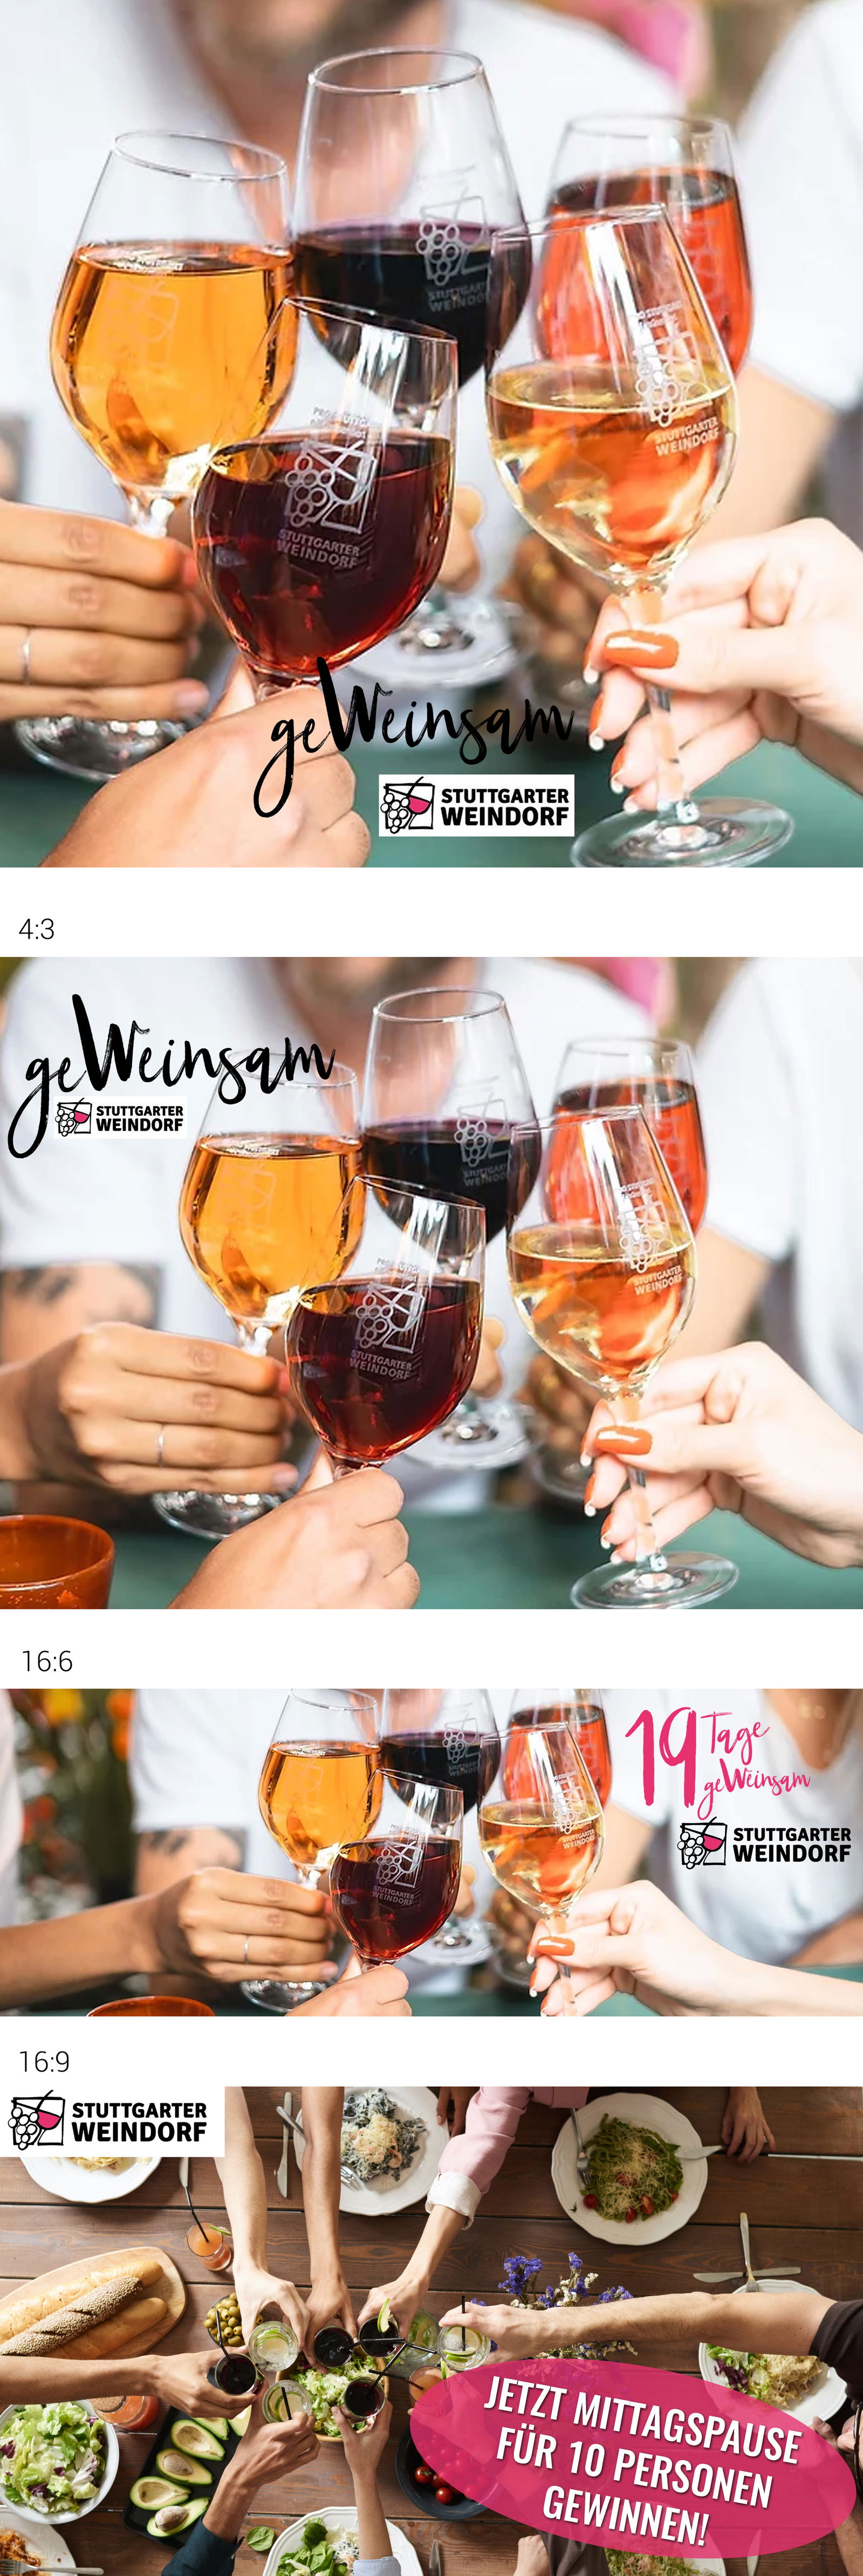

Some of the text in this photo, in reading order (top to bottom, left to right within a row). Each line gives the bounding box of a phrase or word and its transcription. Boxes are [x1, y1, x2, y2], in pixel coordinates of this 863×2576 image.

[654, 416, 718, 443] STUTTGARTER
[656, 427, 719, 456] WEINDORF
[277, 539, 359, 569] WEINDORF
[278, 529, 360, 557] STUTTGARTER
[634, 1273, 682, 1295] WEINDORF
[350, 1358, 411, 1379] WEINDORF
[351, 1349, 412, 1370] STUTTGARTER
[372, 1891, 414, 1906] WEINDORF
[373, 1885, 414, 1899] STUTTGARTER
